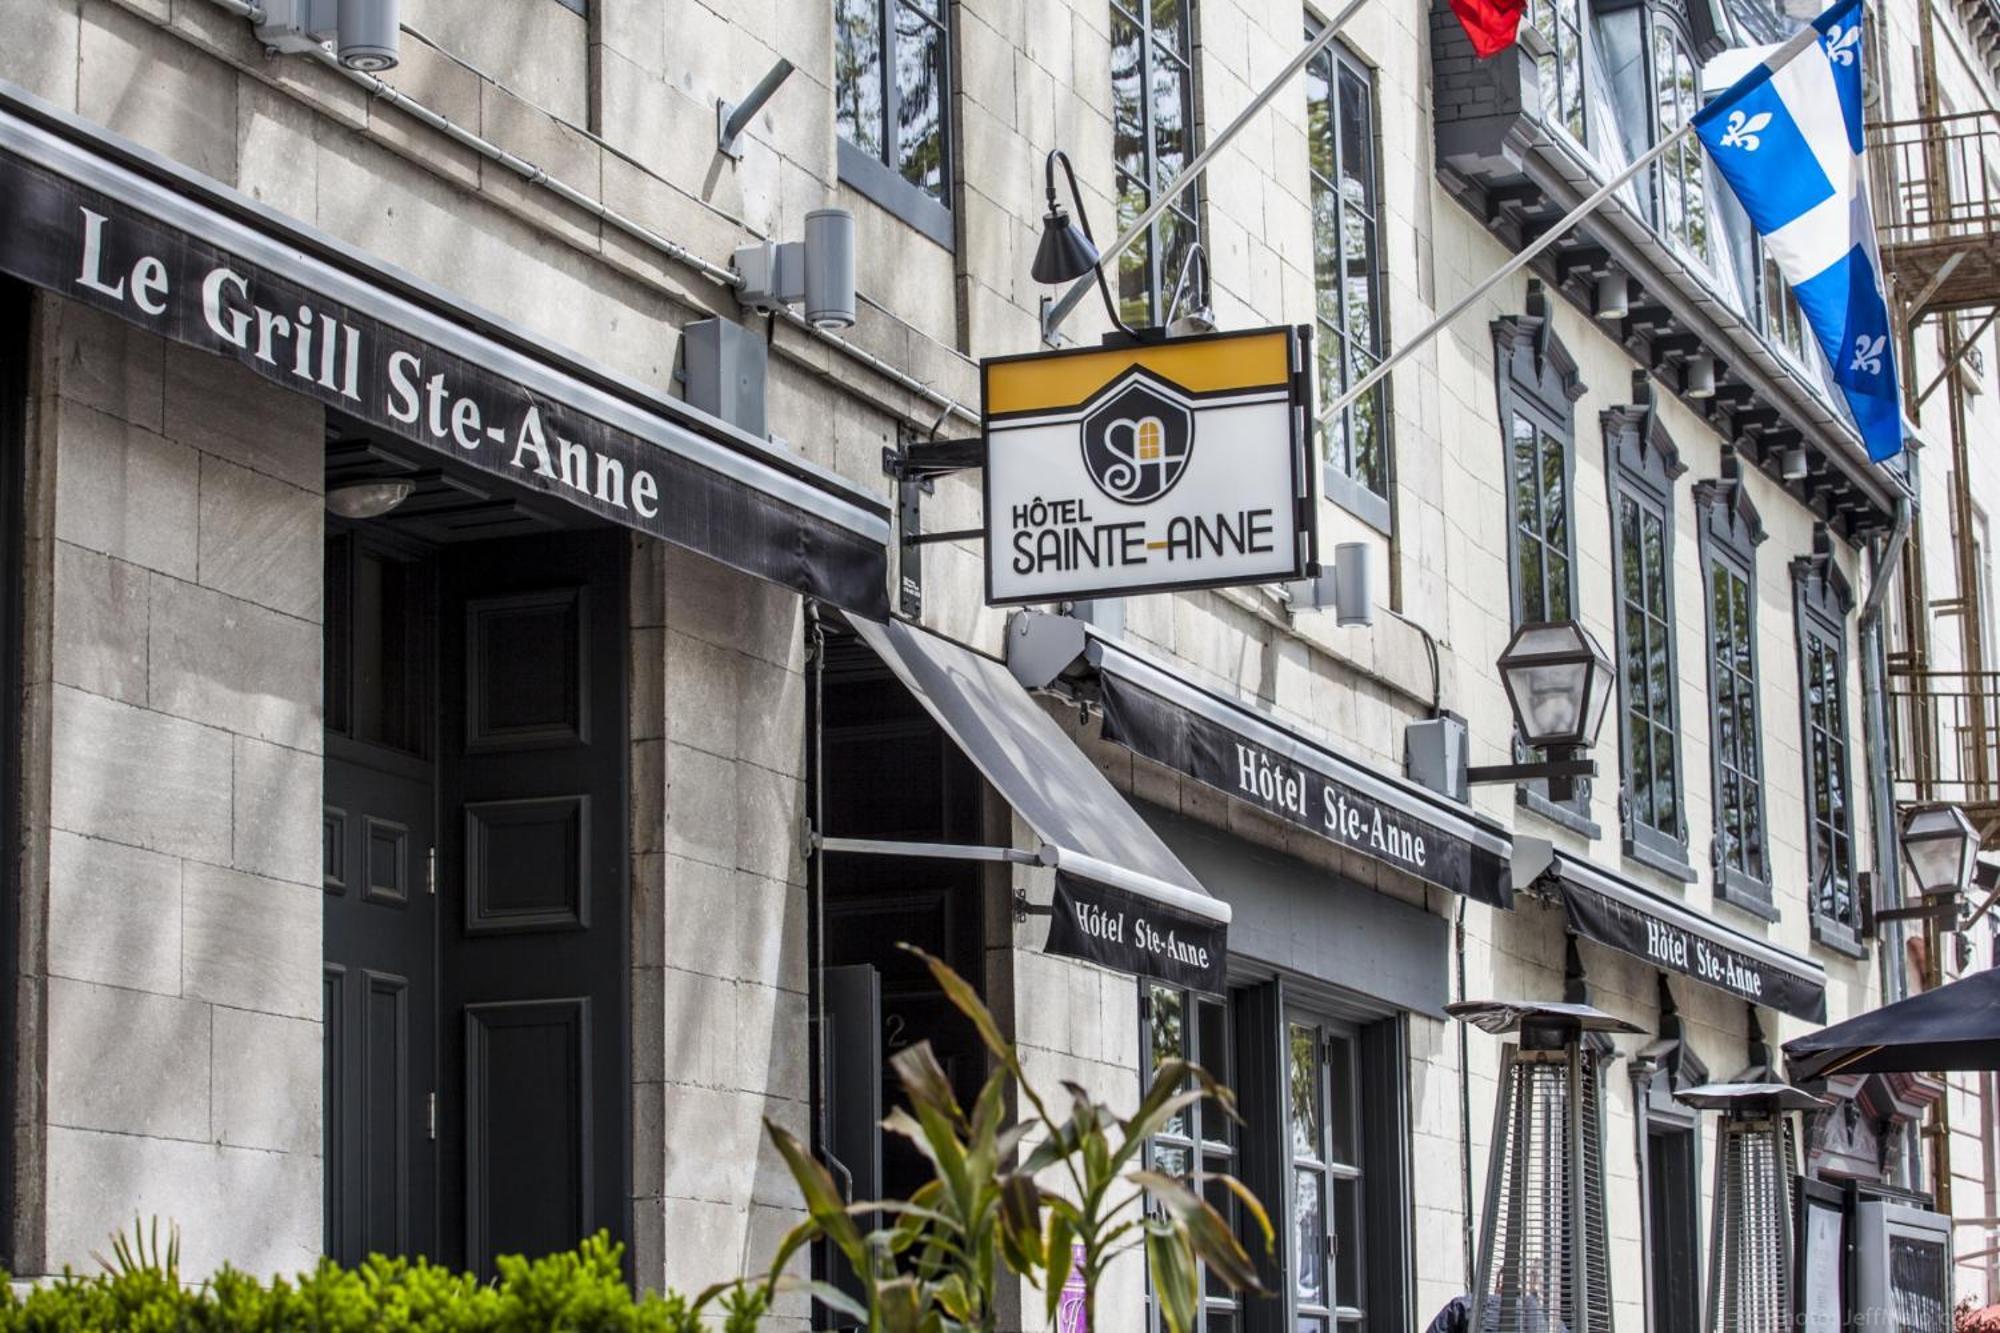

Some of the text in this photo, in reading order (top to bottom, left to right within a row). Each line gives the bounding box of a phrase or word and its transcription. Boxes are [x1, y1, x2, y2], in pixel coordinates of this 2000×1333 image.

[75, 206, 658, 519] Le Grill Ste-Anne
[1012, 496, 1092, 529] HÔTEL
[1012, 509, 1274, 575] SAINTE-ANNE
[1236, 743, 1427, 867] Hôtel Ste-Anne
[1074, 900, 1210, 971] Hôtel Ste-Anne
[1646, 920, 1762, 996] Hôtel Ste-Anne
